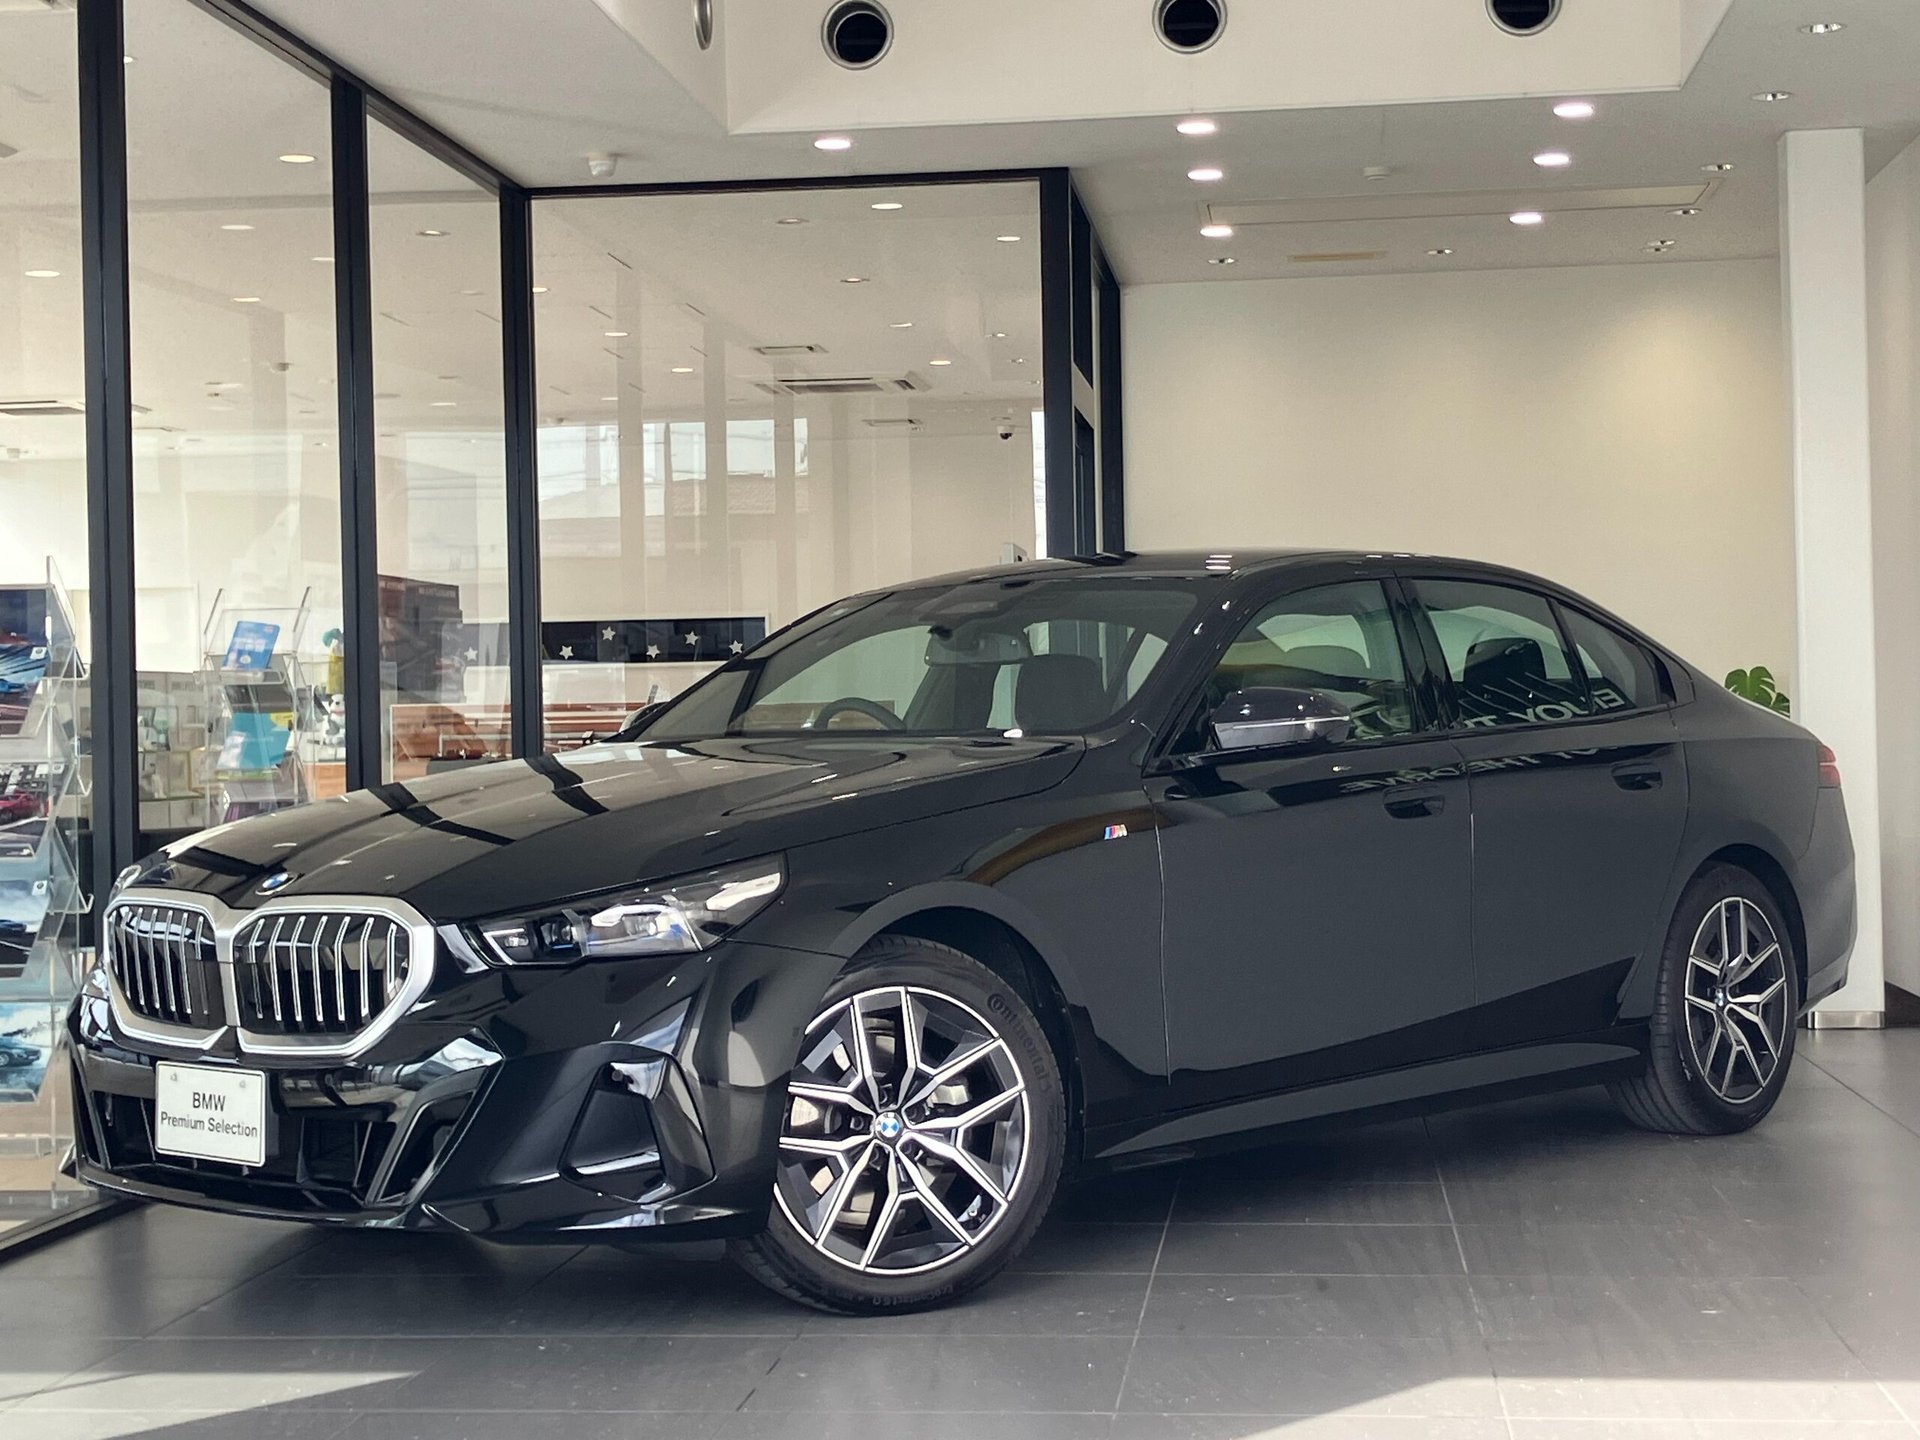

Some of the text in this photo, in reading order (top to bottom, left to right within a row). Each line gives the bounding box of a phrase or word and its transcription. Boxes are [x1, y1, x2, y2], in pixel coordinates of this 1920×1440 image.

[192, 1092, 226, 1112] BMW
[160, 1111, 258, 1138] Premium Selection
